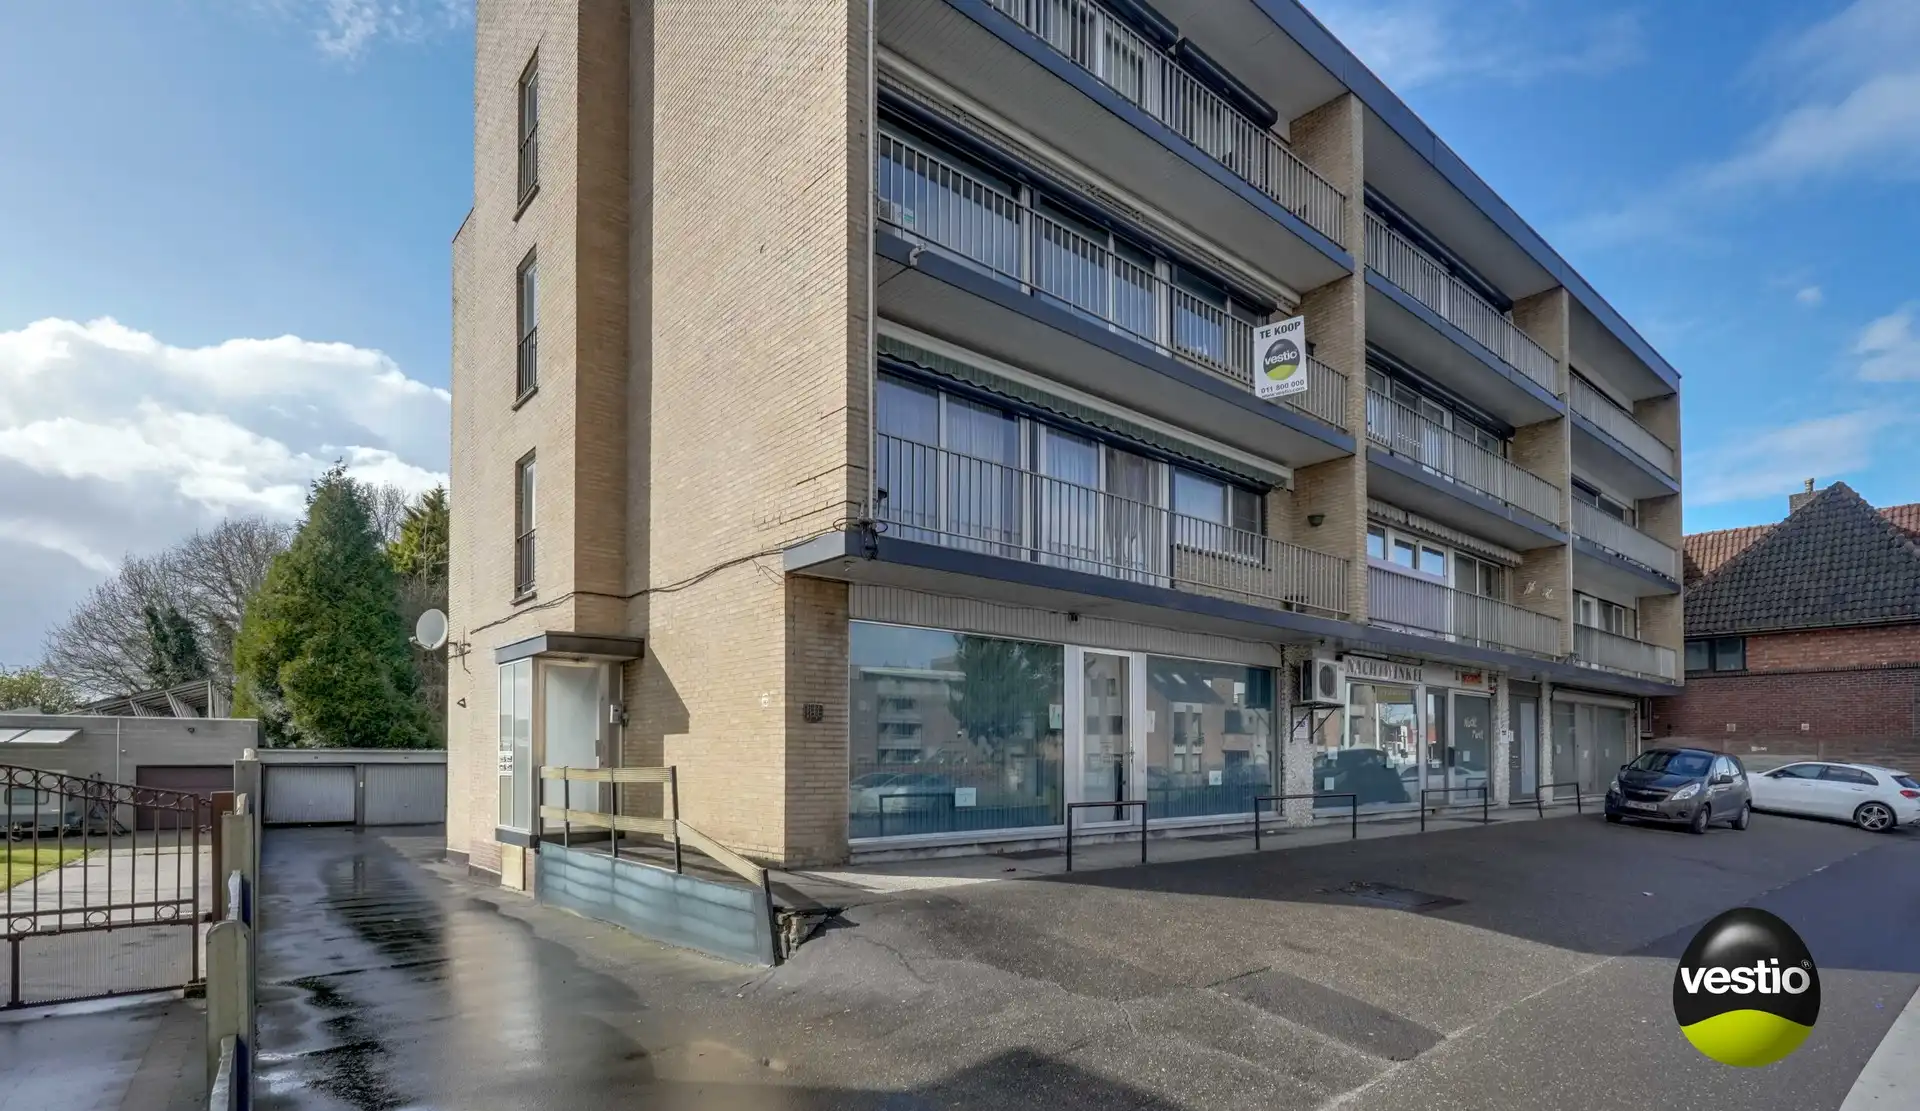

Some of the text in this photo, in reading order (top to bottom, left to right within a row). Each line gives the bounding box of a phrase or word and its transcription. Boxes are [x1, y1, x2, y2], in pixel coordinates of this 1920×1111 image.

[1260, 321, 1301, 339] TE KOOP
[1264, 350, 1298, 365] vestio
[1261, 379, 1304, 394] 011 800 000
